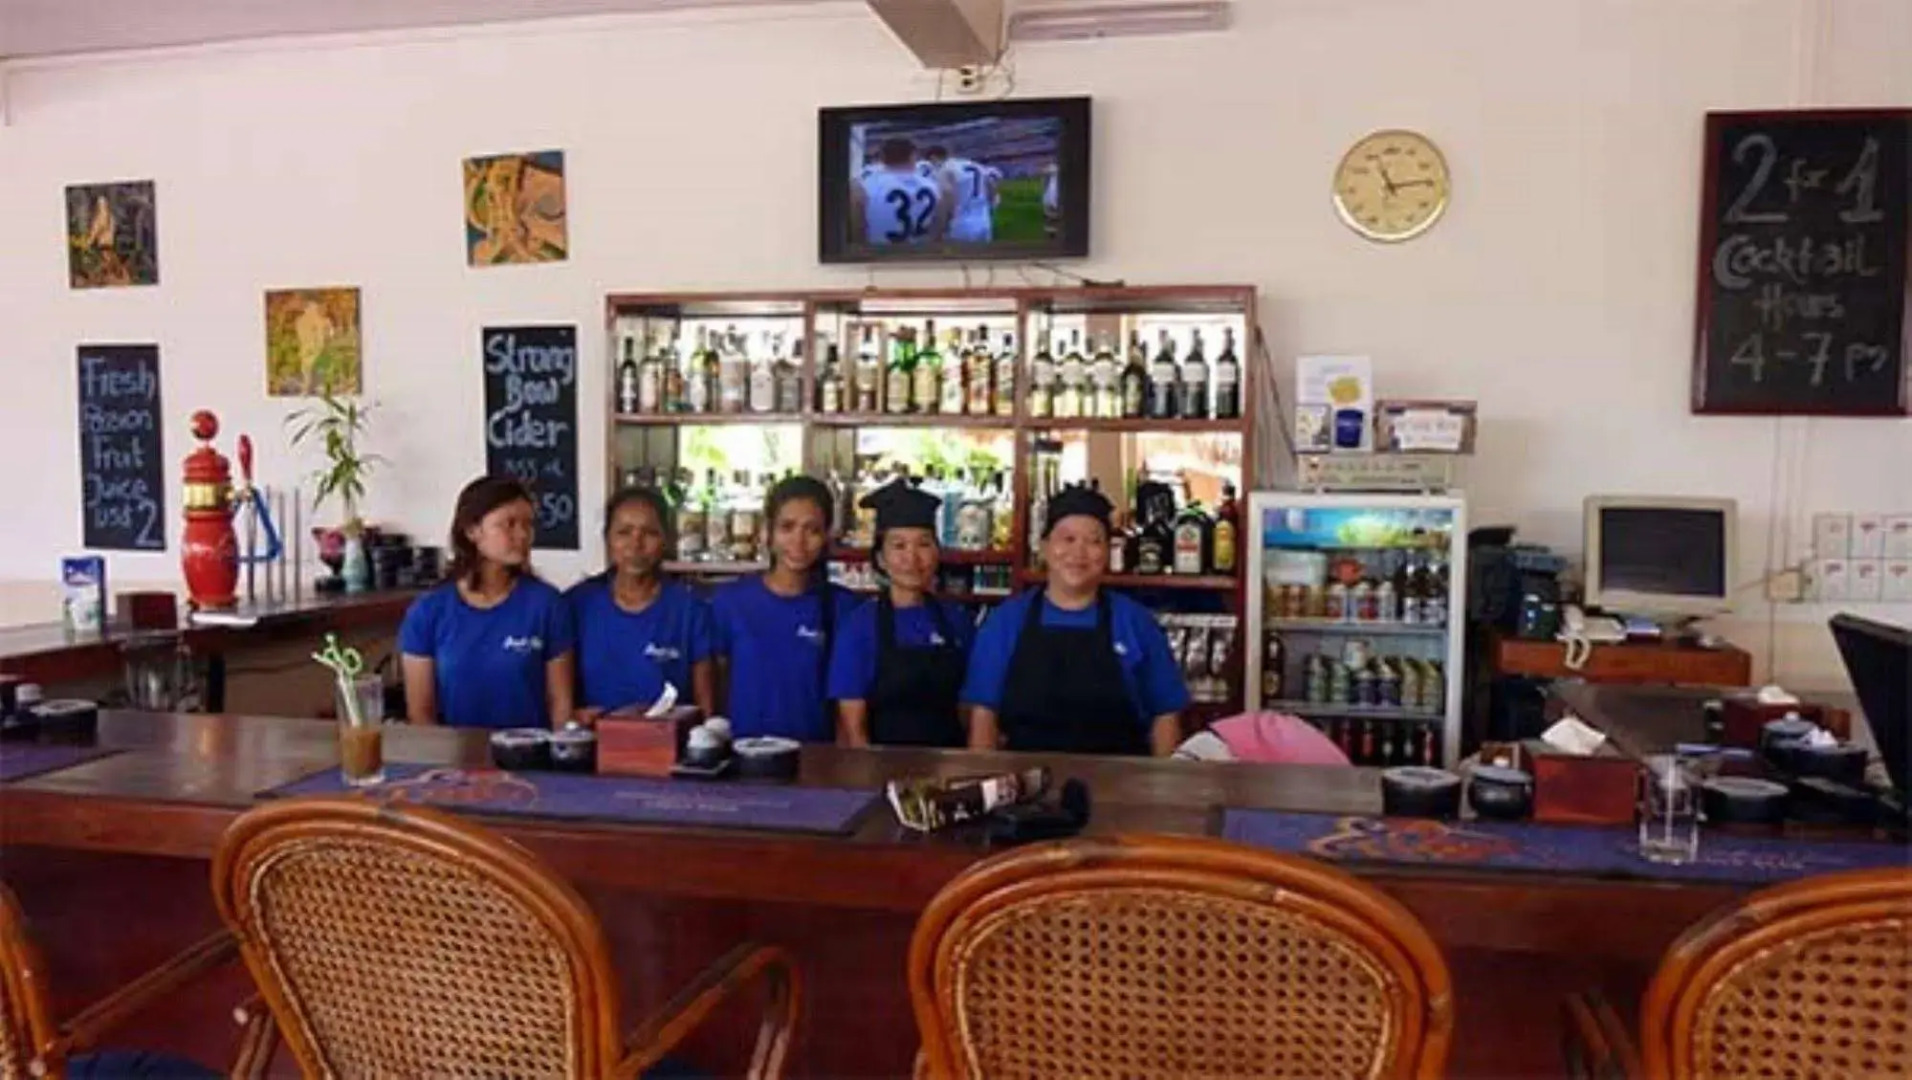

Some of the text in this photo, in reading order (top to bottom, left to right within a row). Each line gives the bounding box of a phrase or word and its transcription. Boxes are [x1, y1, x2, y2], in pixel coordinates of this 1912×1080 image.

[964, 166, 982, 199] 7
[1725, 133, 1788, 223] 2
[1835, 134, 1885, 222] 1
[885, 188, 937, 242] 32
[1752, 282, 1845, 331] Hours
[82, 357, 156, 400] Fresh
[485, 334, 574, 386] Strong
[505, 374, 558, 413] Bow
[487, 410, 568, 448] Cider
[92, 435, 144, 470] Fruit
[85, 472, 148, 507] Juice
[134, 499, 164, 547] 2
